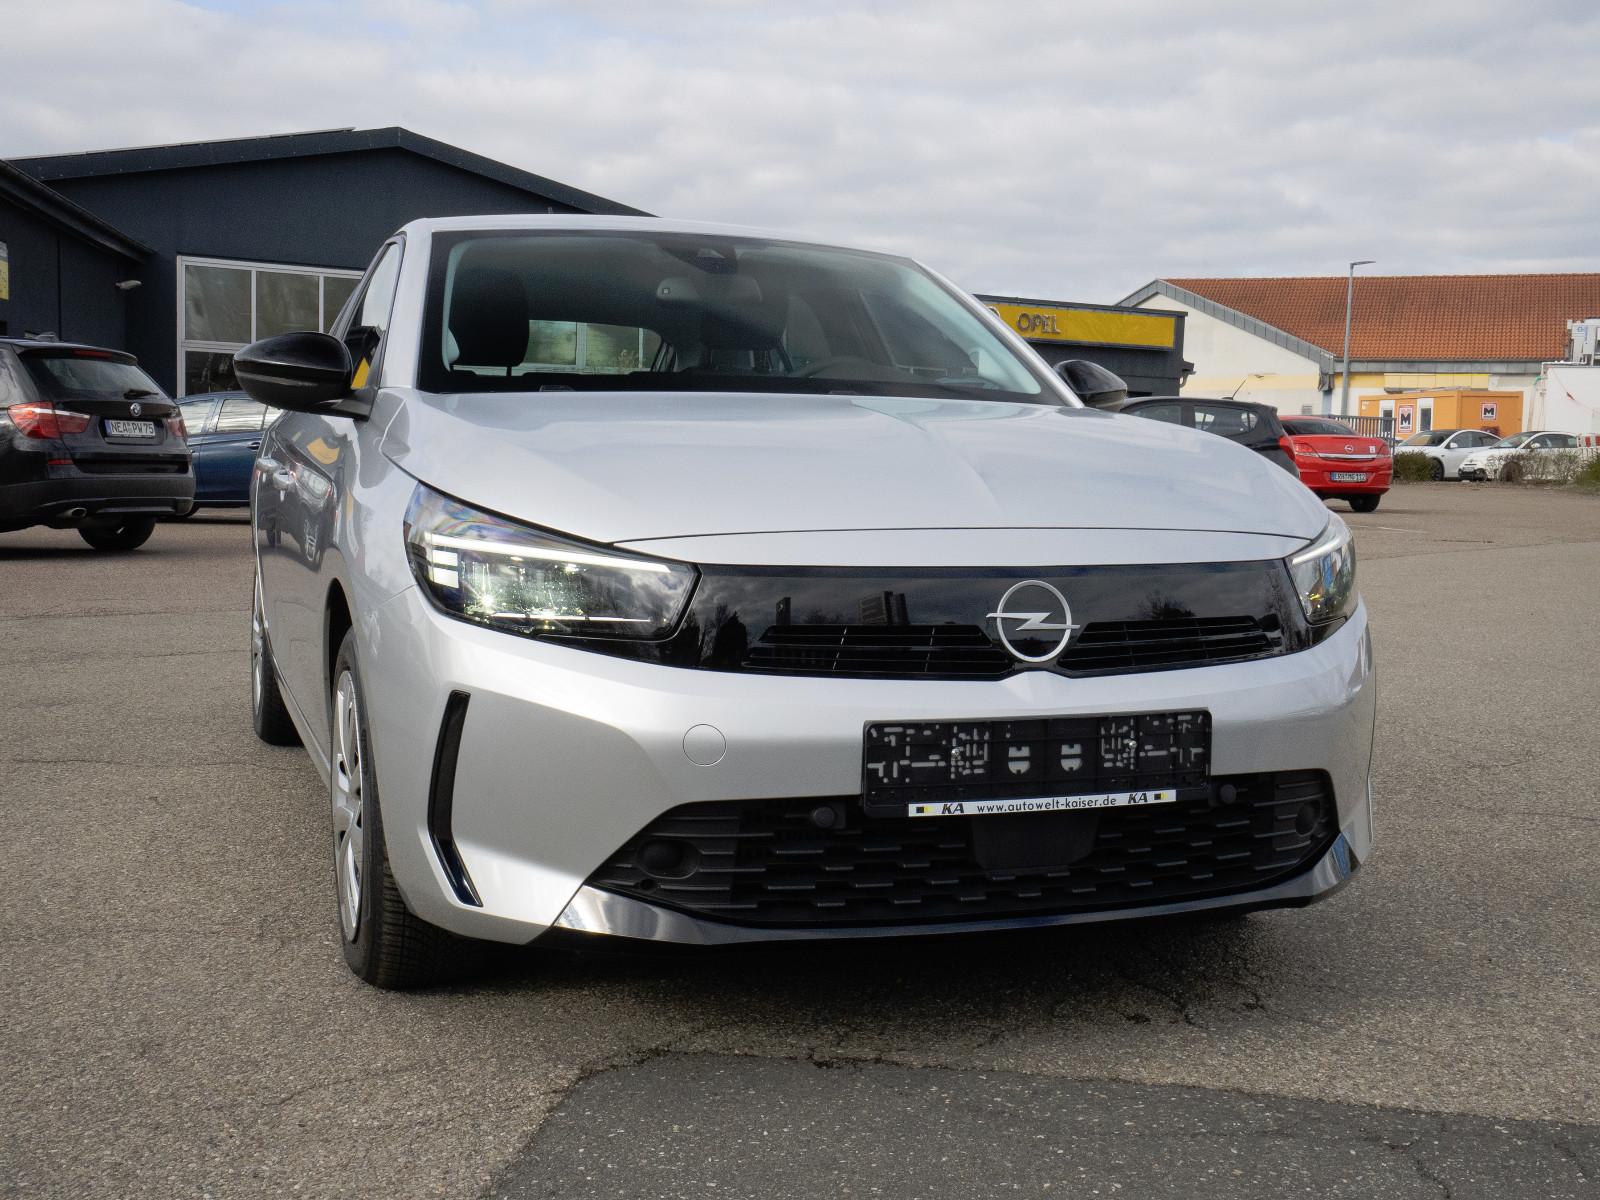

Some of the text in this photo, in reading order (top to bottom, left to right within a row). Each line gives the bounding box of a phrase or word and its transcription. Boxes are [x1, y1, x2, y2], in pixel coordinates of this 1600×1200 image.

[1017, 312, 1061, 334] OPEL
[111, 421, 128, 433] NEA
[941, 792, 1148, 815] KA www.autowelt-kaiser.de KA
